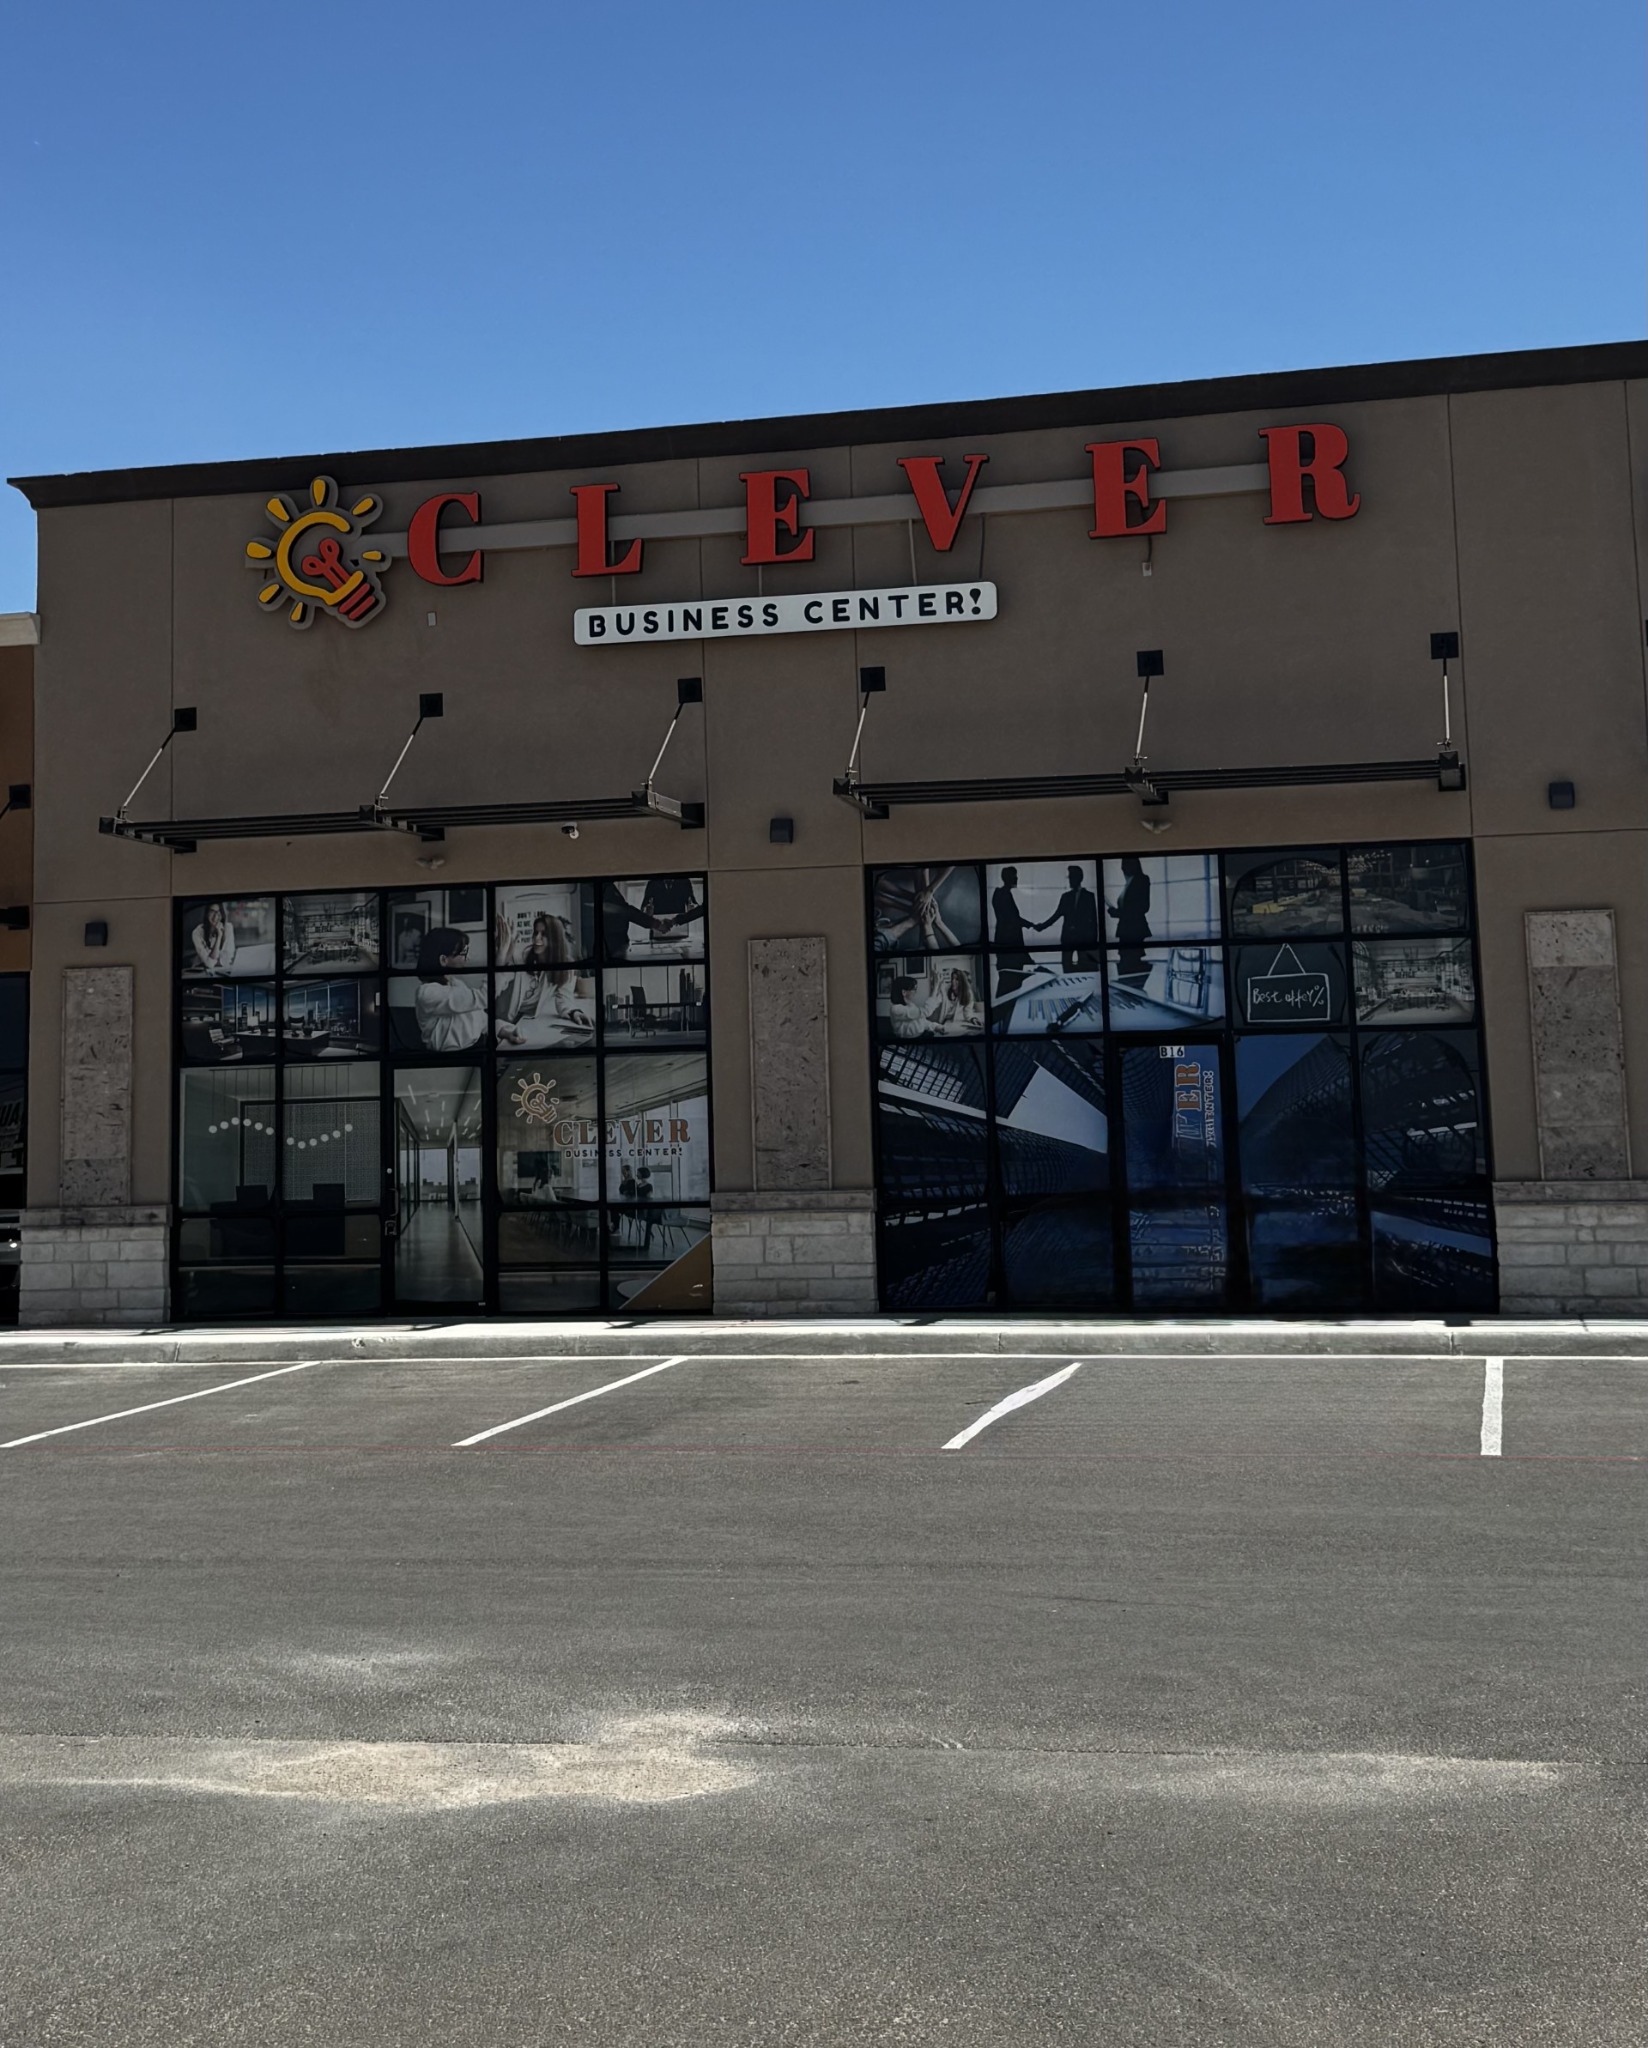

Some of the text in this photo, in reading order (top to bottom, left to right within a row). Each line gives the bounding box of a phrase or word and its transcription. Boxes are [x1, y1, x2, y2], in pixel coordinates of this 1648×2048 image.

[407, 421, 1362, 586] CLEVER
[588, 588, 982, 638] BUSINESS CENTER!
[1160, 1046, 1184, 1057] B16
[553, 1118, 691, 1146] CLEVER
[565, 1149, 623, 1158] BUSINSS
